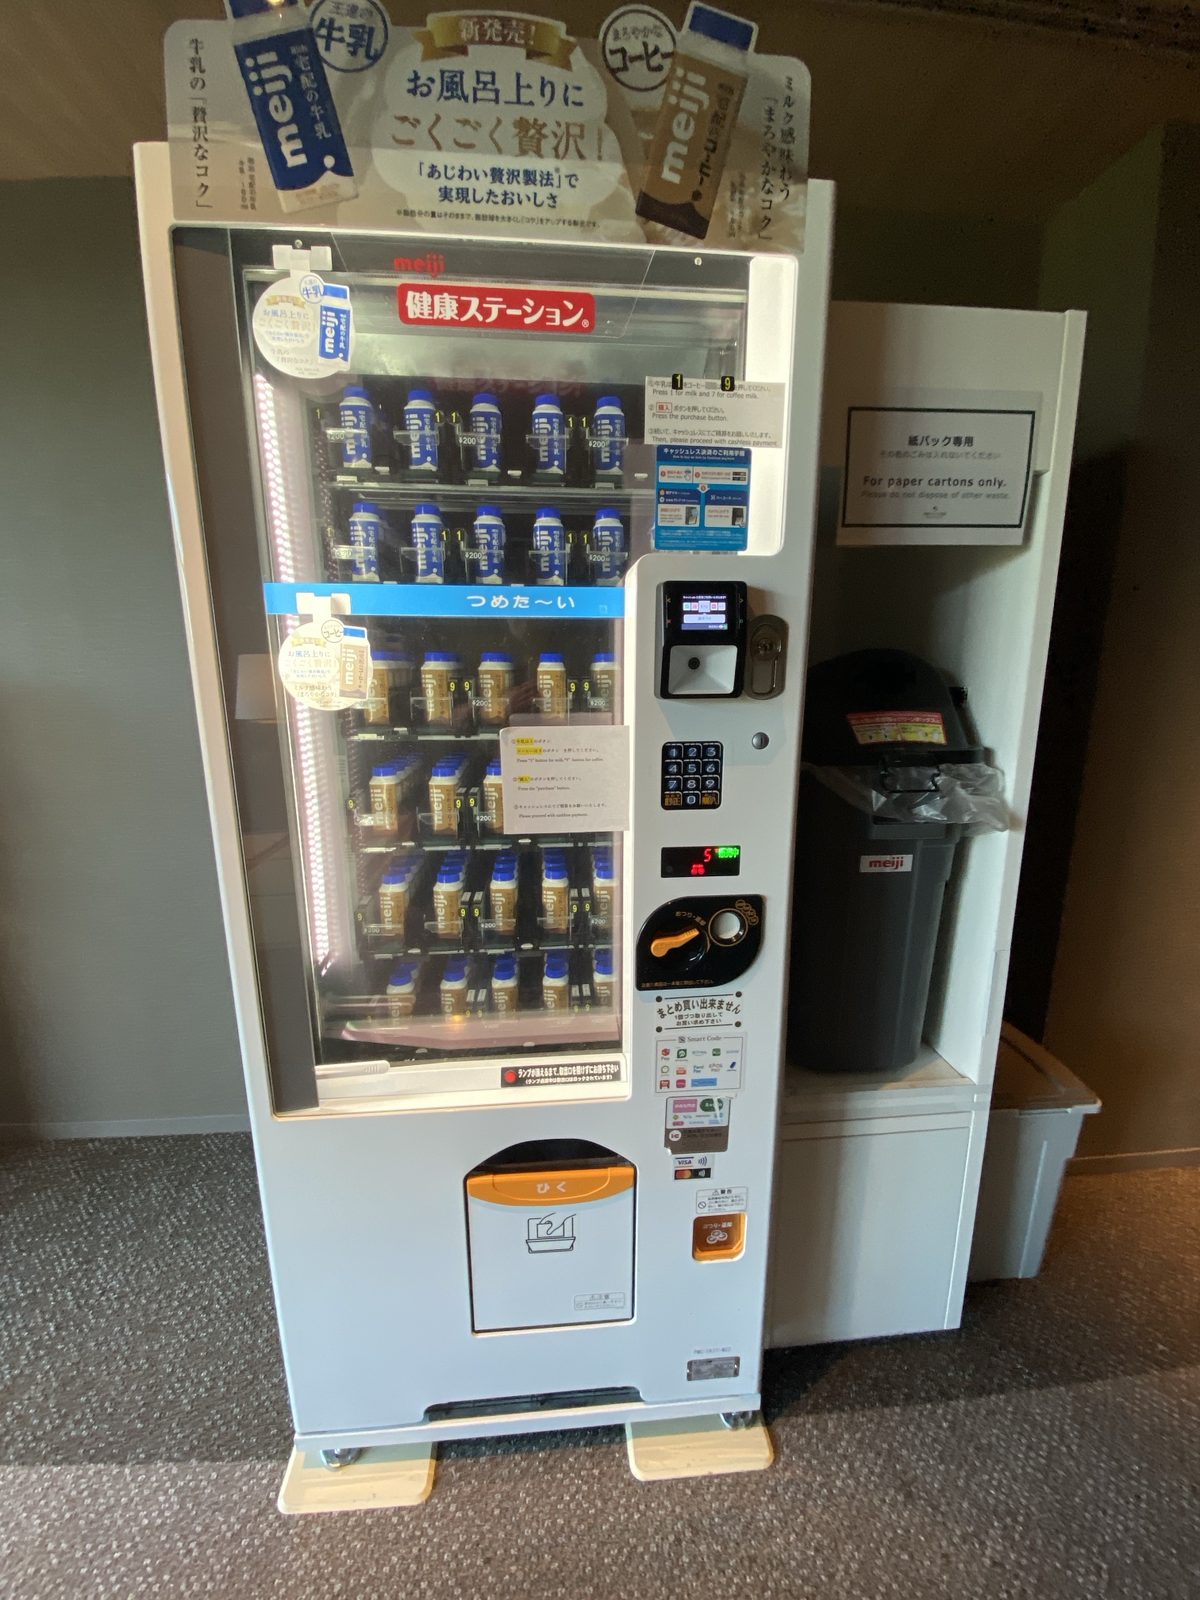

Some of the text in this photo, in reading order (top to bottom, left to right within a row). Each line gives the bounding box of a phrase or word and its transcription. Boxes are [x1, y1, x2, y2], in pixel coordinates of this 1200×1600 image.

[315, 16, 380, 61] 牛乳
[608, 40, 676, 74] コーヒー
[405, 69, 585, 108] お風呂上りに
[244, 50, 308, 168] meiji
[660, 66, 711, 185] meiji
[390, 112, 604, 161] ごくごく贅沢！
[437, 184, 560, 210] 実現したおいしさ
[393, 253, 446, 278] meiji
[321, 310, 339, 353] meiji
[652, 389, 669, 397] Press
[726, 392, 745, 401] coffee
[680, 414, 707, 423] purchase
[689, 438, 713, 446] proceed
[714, 438, 726, 446] with
[907, 434, 975, 448] 紙パック専用
[862, 475, 1007, 490] For paper cartons only.
[341, 648, 358, 685] meiji
[670, 747, 716, 757] 1 2 3
[668, 764, 716, 773] 4 5 6
[667, 780, 715, 789] 7 8 9
[686, 795, 697, 805] 0
[868, 856, 904, 871] meiji
[656, 998, 742, 1019] まとめ買い出来ません
[675, 1018, 723, 1027] お買い求め下さい
[536, 1182, 567, 1194] ひく
